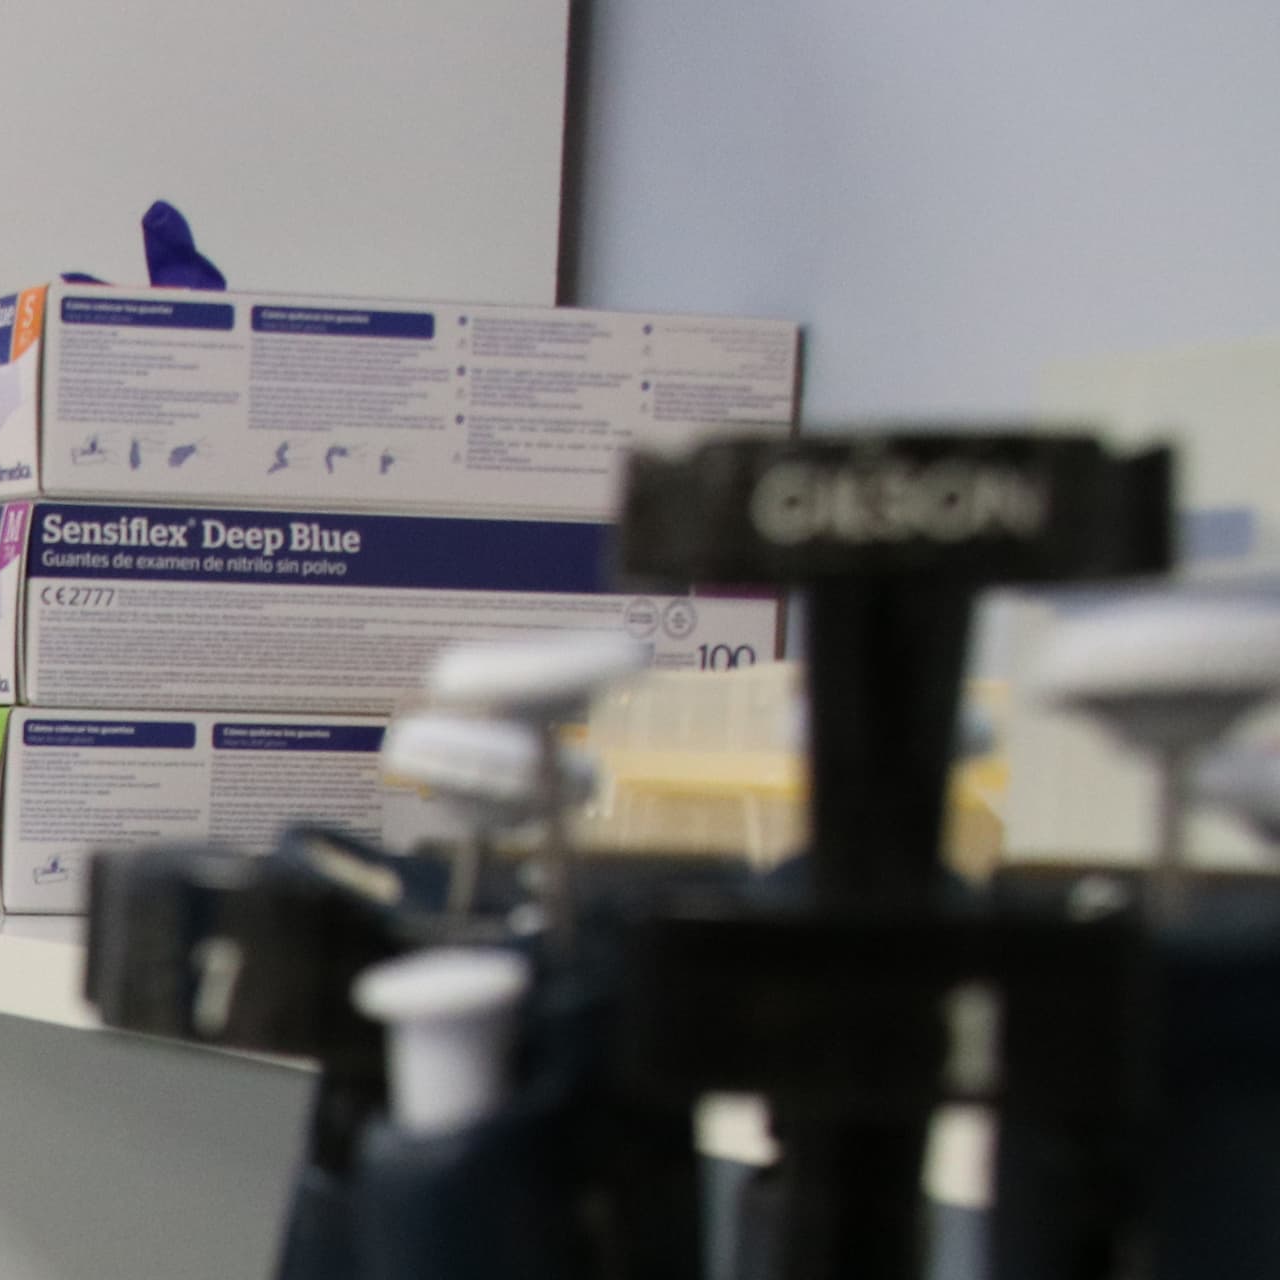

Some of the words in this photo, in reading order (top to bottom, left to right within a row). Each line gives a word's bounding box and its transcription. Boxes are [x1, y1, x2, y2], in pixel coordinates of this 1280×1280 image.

[22, 295, 37, 329] S
[5, 510, 24, 544] M
[202, 519, 284, 555] Deep
[289, 522, 361, 553] Blue
[42, 549, 110, 568] Guantes
[113, 552, 132, 569] de
[136, 556, 200, 571] examen
[203, 555, 223, 571] de
[227, 556, 273, 573] nitrilo
[276, 558, 299, 574] sin
[302, 559, 347, 576] polvo
[69, 587, 115, 607] 2777
